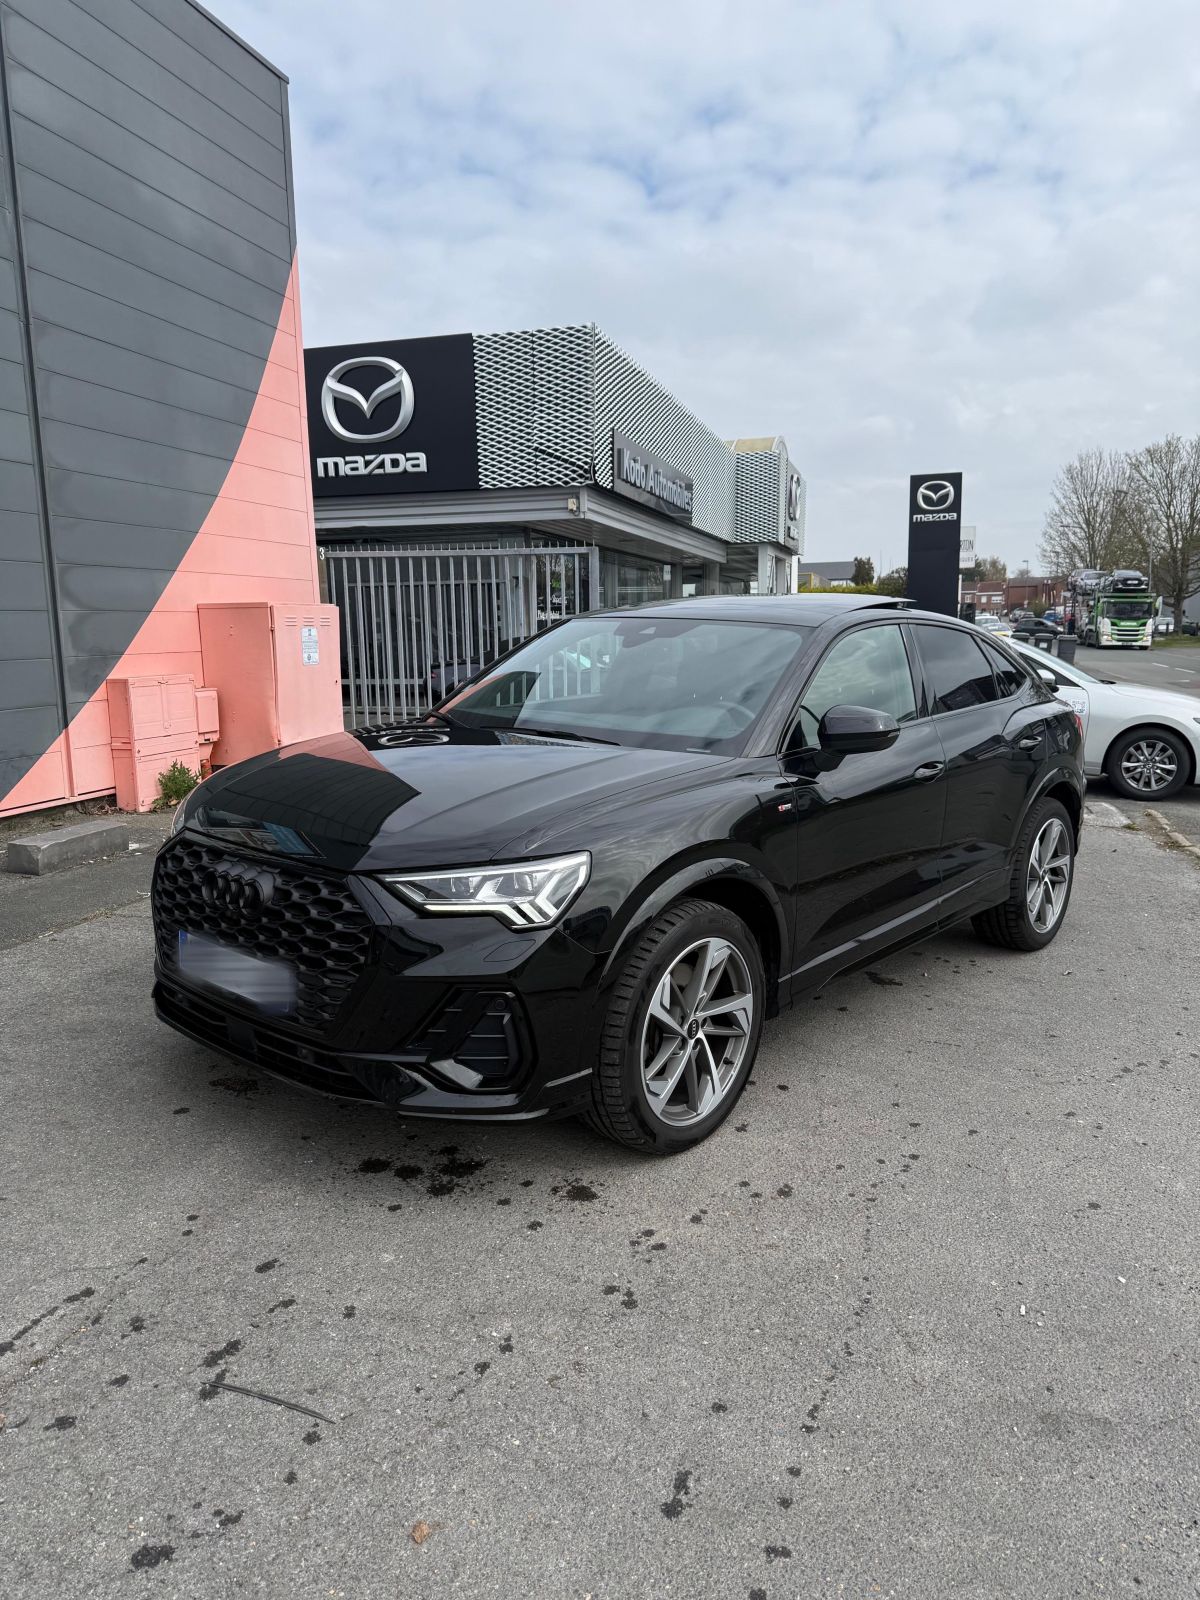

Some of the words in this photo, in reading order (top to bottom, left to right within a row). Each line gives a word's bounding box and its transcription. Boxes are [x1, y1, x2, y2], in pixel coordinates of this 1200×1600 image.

[316, 452, 428, 478] mazda
[620, 447, 647, 489] Kodo
[648, 463, 693, 512] Automobiles
[912, 512, 958, 523] mazda
[319, 547, 325, 560] 3
